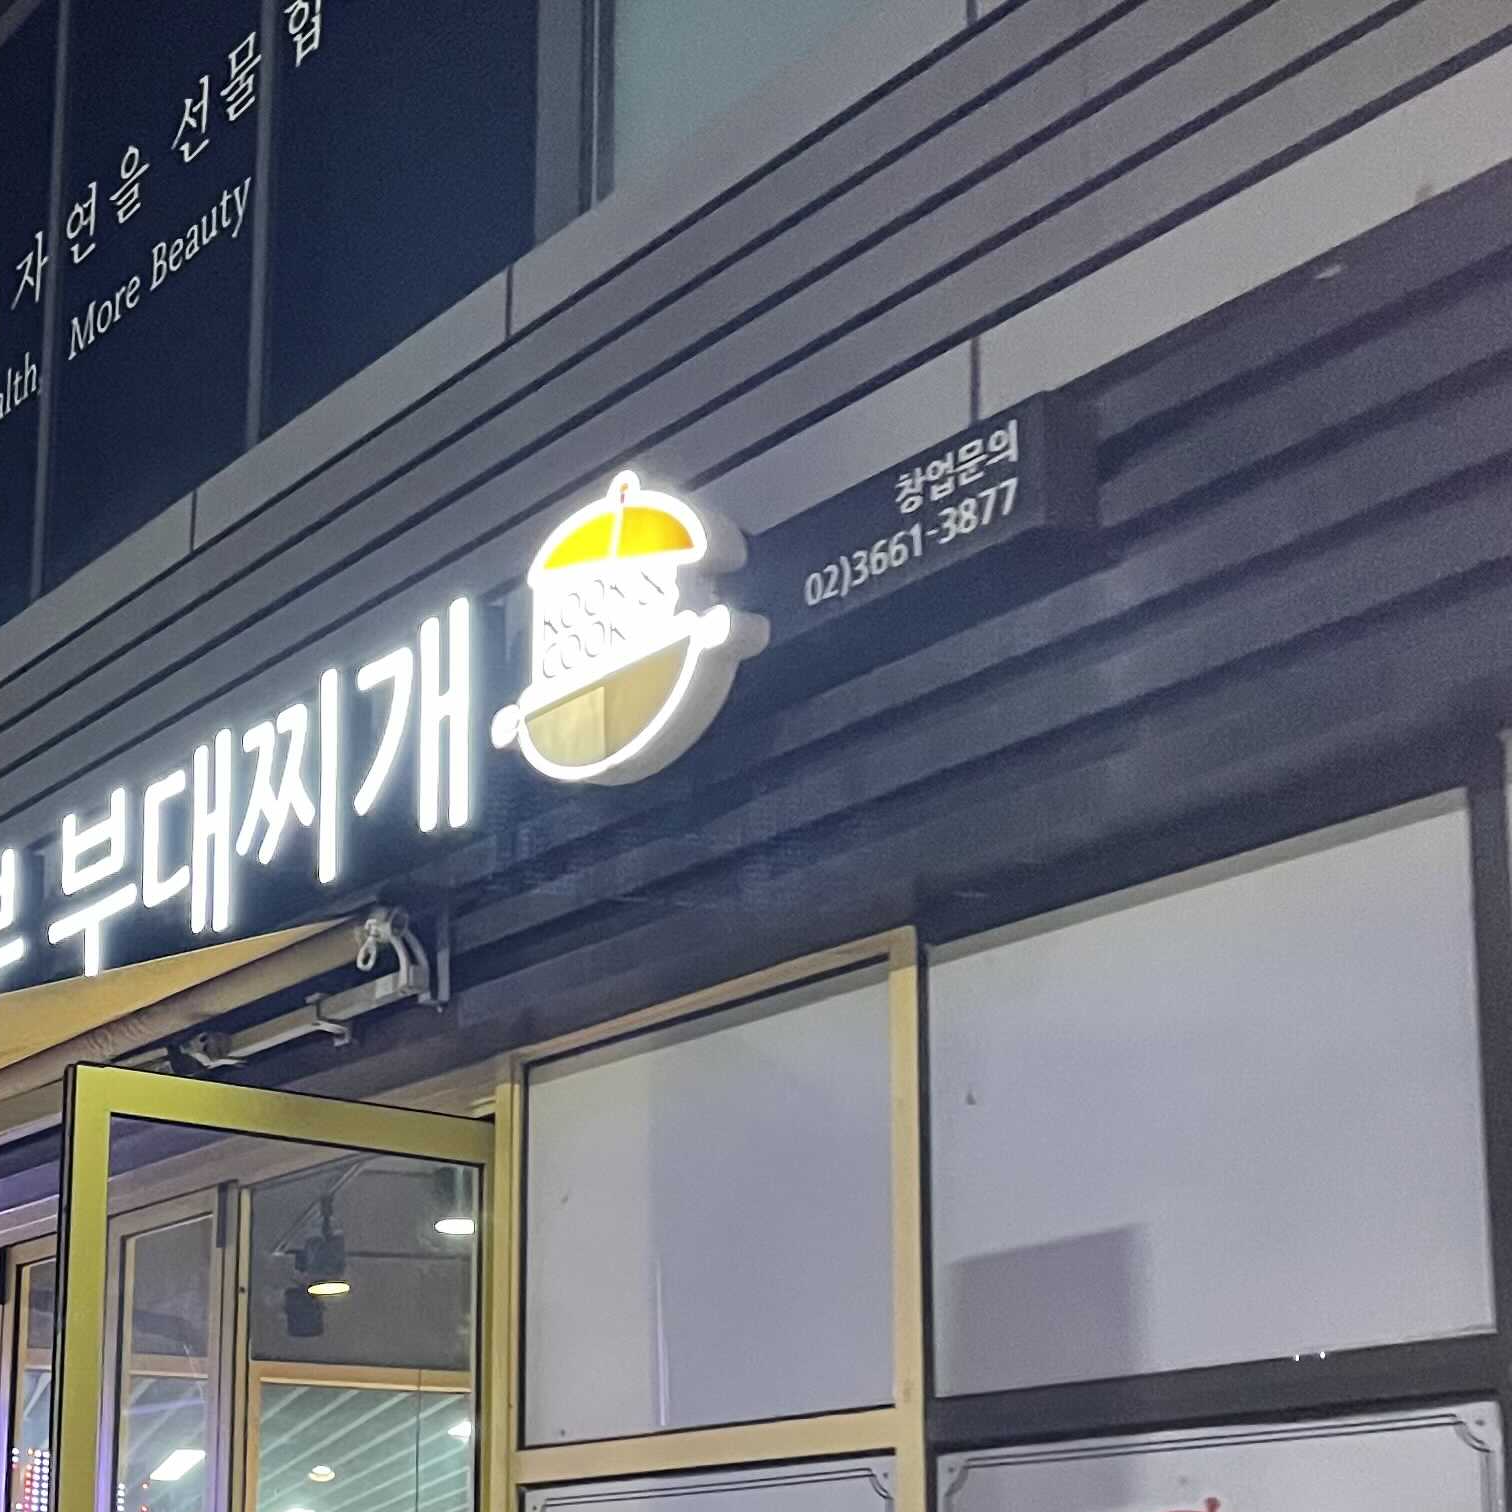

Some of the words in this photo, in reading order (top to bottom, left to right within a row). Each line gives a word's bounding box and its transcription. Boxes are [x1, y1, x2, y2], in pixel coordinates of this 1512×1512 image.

[68, 276, 141, 360] More
[149, 177, 251, 291] Beauty
[804, 476, 1018, 606] 02)3661-3877
[894, 420, 1018, 514] 창업문의
[47, 596, 470, 978] 부대찌개
